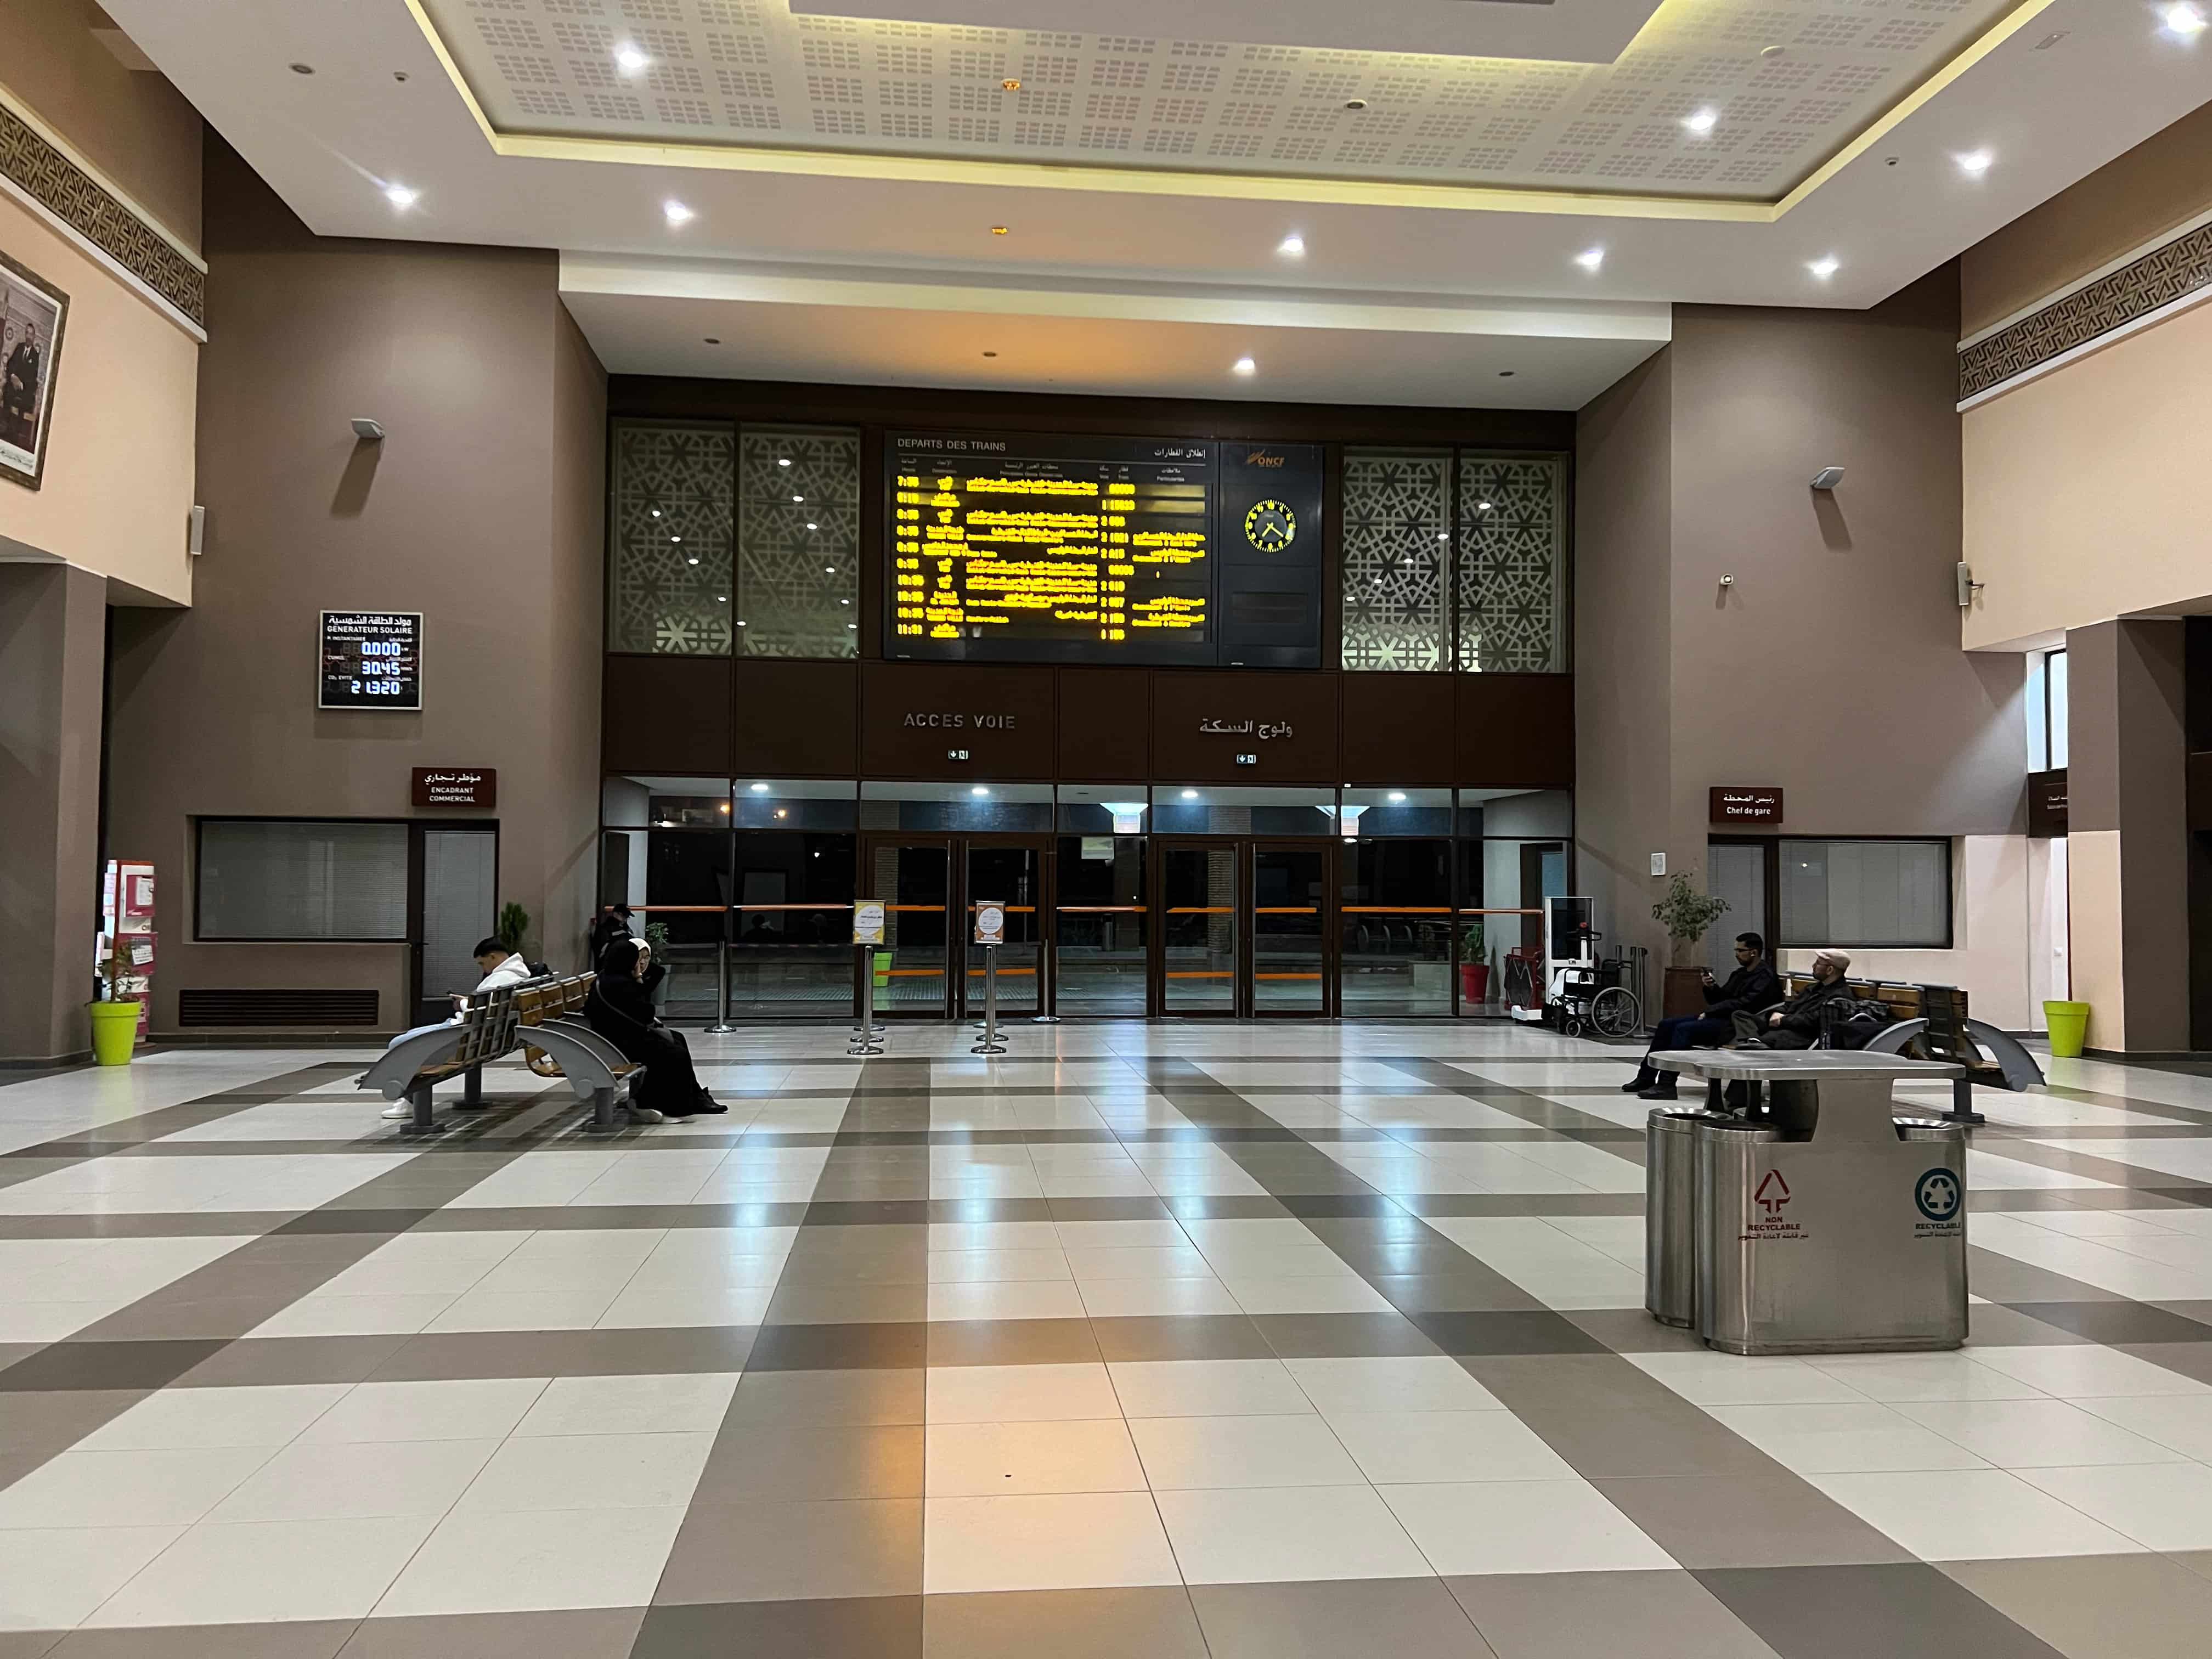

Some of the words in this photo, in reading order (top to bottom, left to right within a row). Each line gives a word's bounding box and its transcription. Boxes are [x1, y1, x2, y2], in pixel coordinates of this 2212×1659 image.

[898, 439, 943, 449] DEPARTS
[947, 440, 967, 449] DES
[971, 441, 1006, 452] TRAINS
[329, 614, 367, 625] الشمسية
[368, 616, 393, 625] الطاقة
[394, 617, 411, 627] مولد
[327, 625, 379, 634] GENERATEUR
[904, 713, 963, 727] ACCES
[974, 715, 1015, 729] VOIE
[1200, 718, 1253, 733] السكة
[1258, 721, 1293, 740] ولوج
[1723, 793, 1753, 802] المحطة
